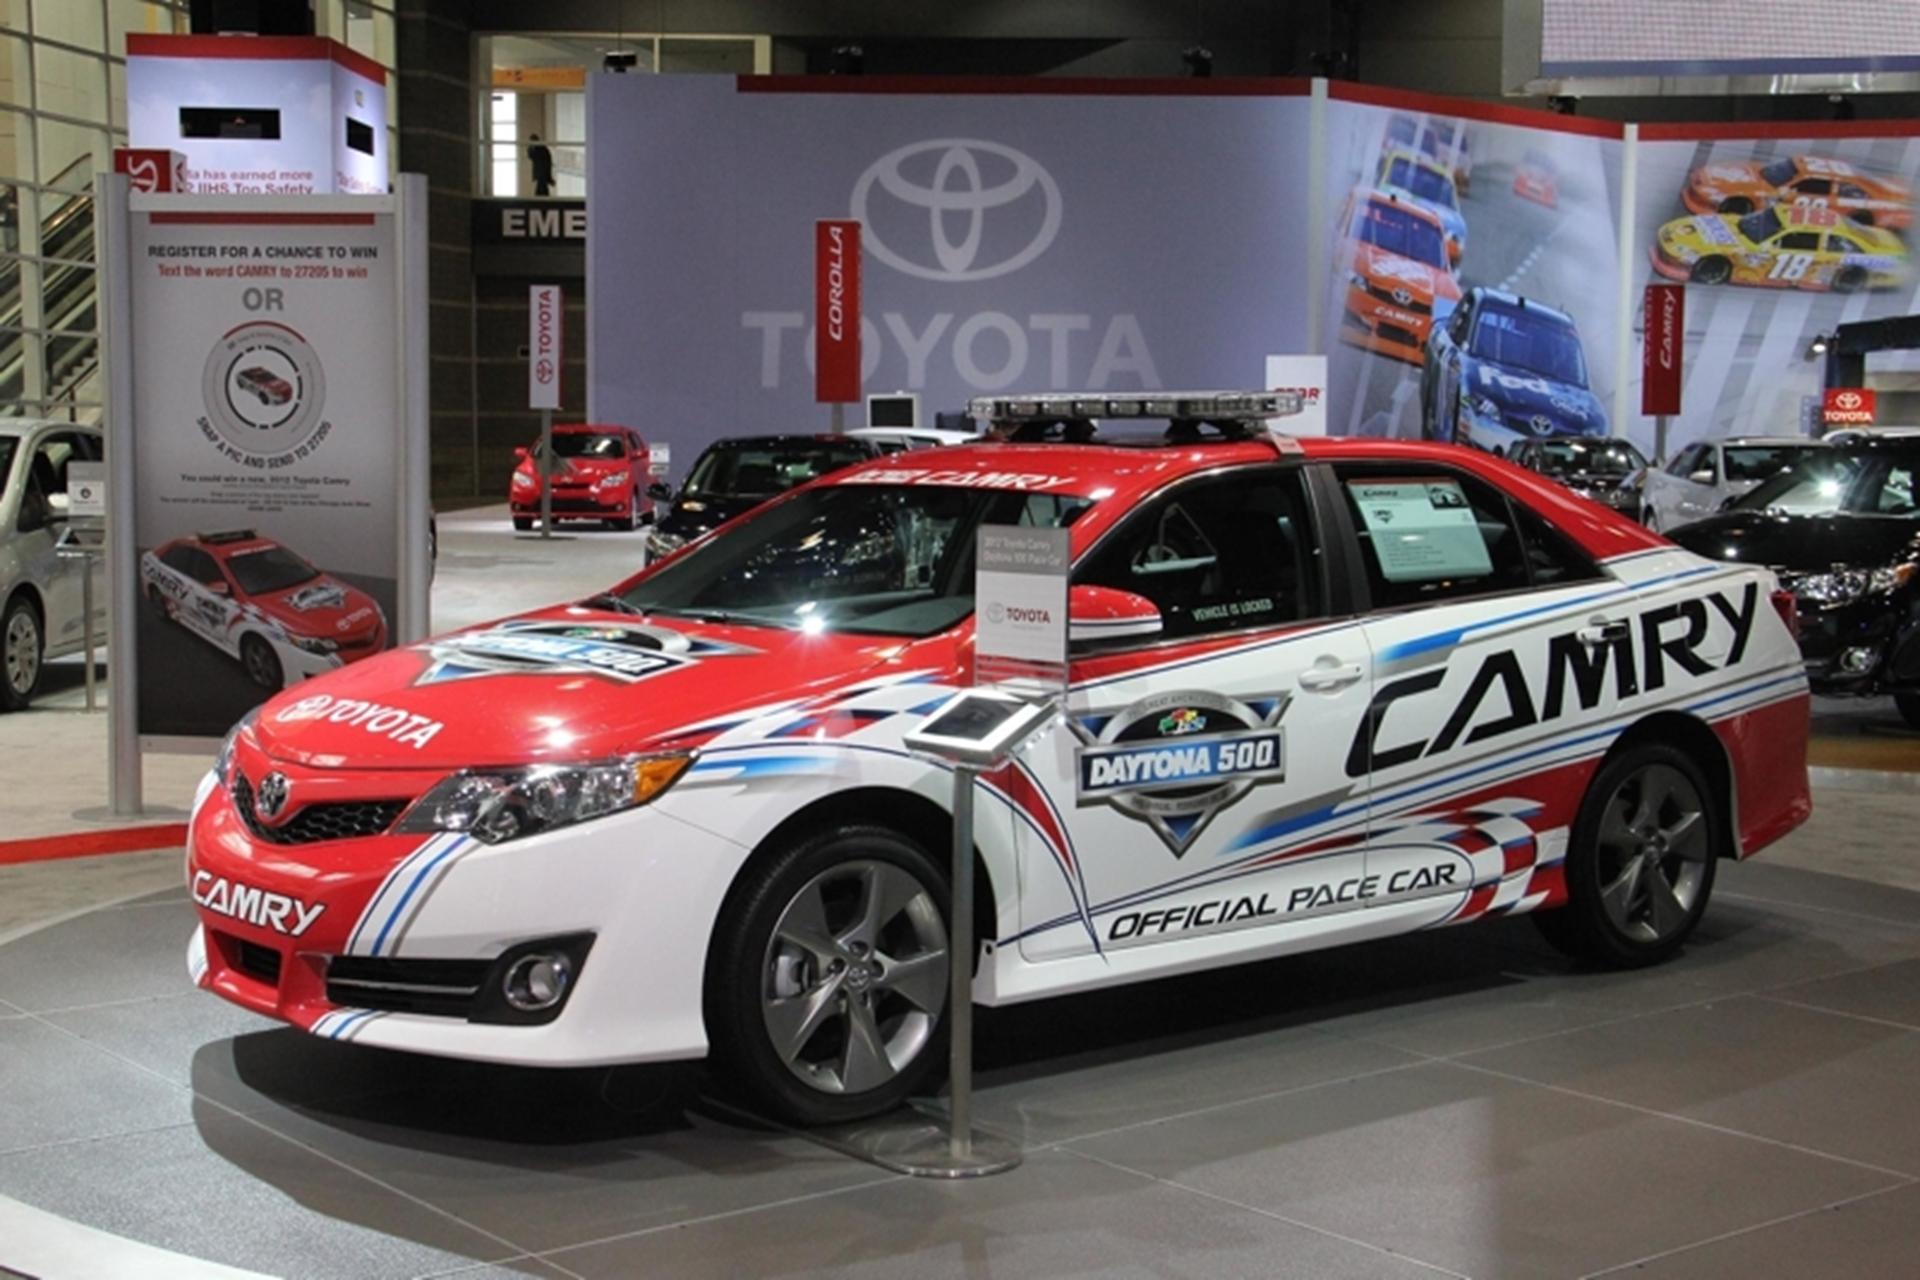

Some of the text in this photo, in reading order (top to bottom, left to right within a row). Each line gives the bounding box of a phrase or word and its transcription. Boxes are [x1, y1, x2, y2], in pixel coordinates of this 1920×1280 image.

[229, 169, 277, 180] earned
[279, 171, 314, 180] more
[265, 181, 313, 194] Safety
[148, 245, 378, 258] REGISTER FOR A CHANCE TO WIN
[158, 263, 180, 277] Text
[183, 264, 202, 277] the
[206, 264, 234, 277] word
[236, 264, 276, 278] CAMRY
[280, 265, 293, 278] to
[332, 265, 344, 278] to
[346, 265, 368, 278] win
[828, 225, 844, 341] COROLLA
[242, 287, 284, 312] OR
[539, 289, 552, 356] TOYOTA
[1660, 288, 1677, 370] CAMRY
[1824, 410, 1873, 422] TOYOTA
[224, 446, 243, 463] PIC
[243, 455, 266, 469] AND
[267, 453, 295, 469] SEND
[294, 445, 309, 460] TO
[1006, 606, 1051, 624] TOYOTA
[1345, 582, 1758, 778] CAMRY
[314, 699, 444, 749] TOYOTA
[1089, 739, 1275, 788] DAYTONA 500
[190, 870, 326, 936] CAMRY
[1108, 863, 1456, 941] OFFICIAL PACE CAR
